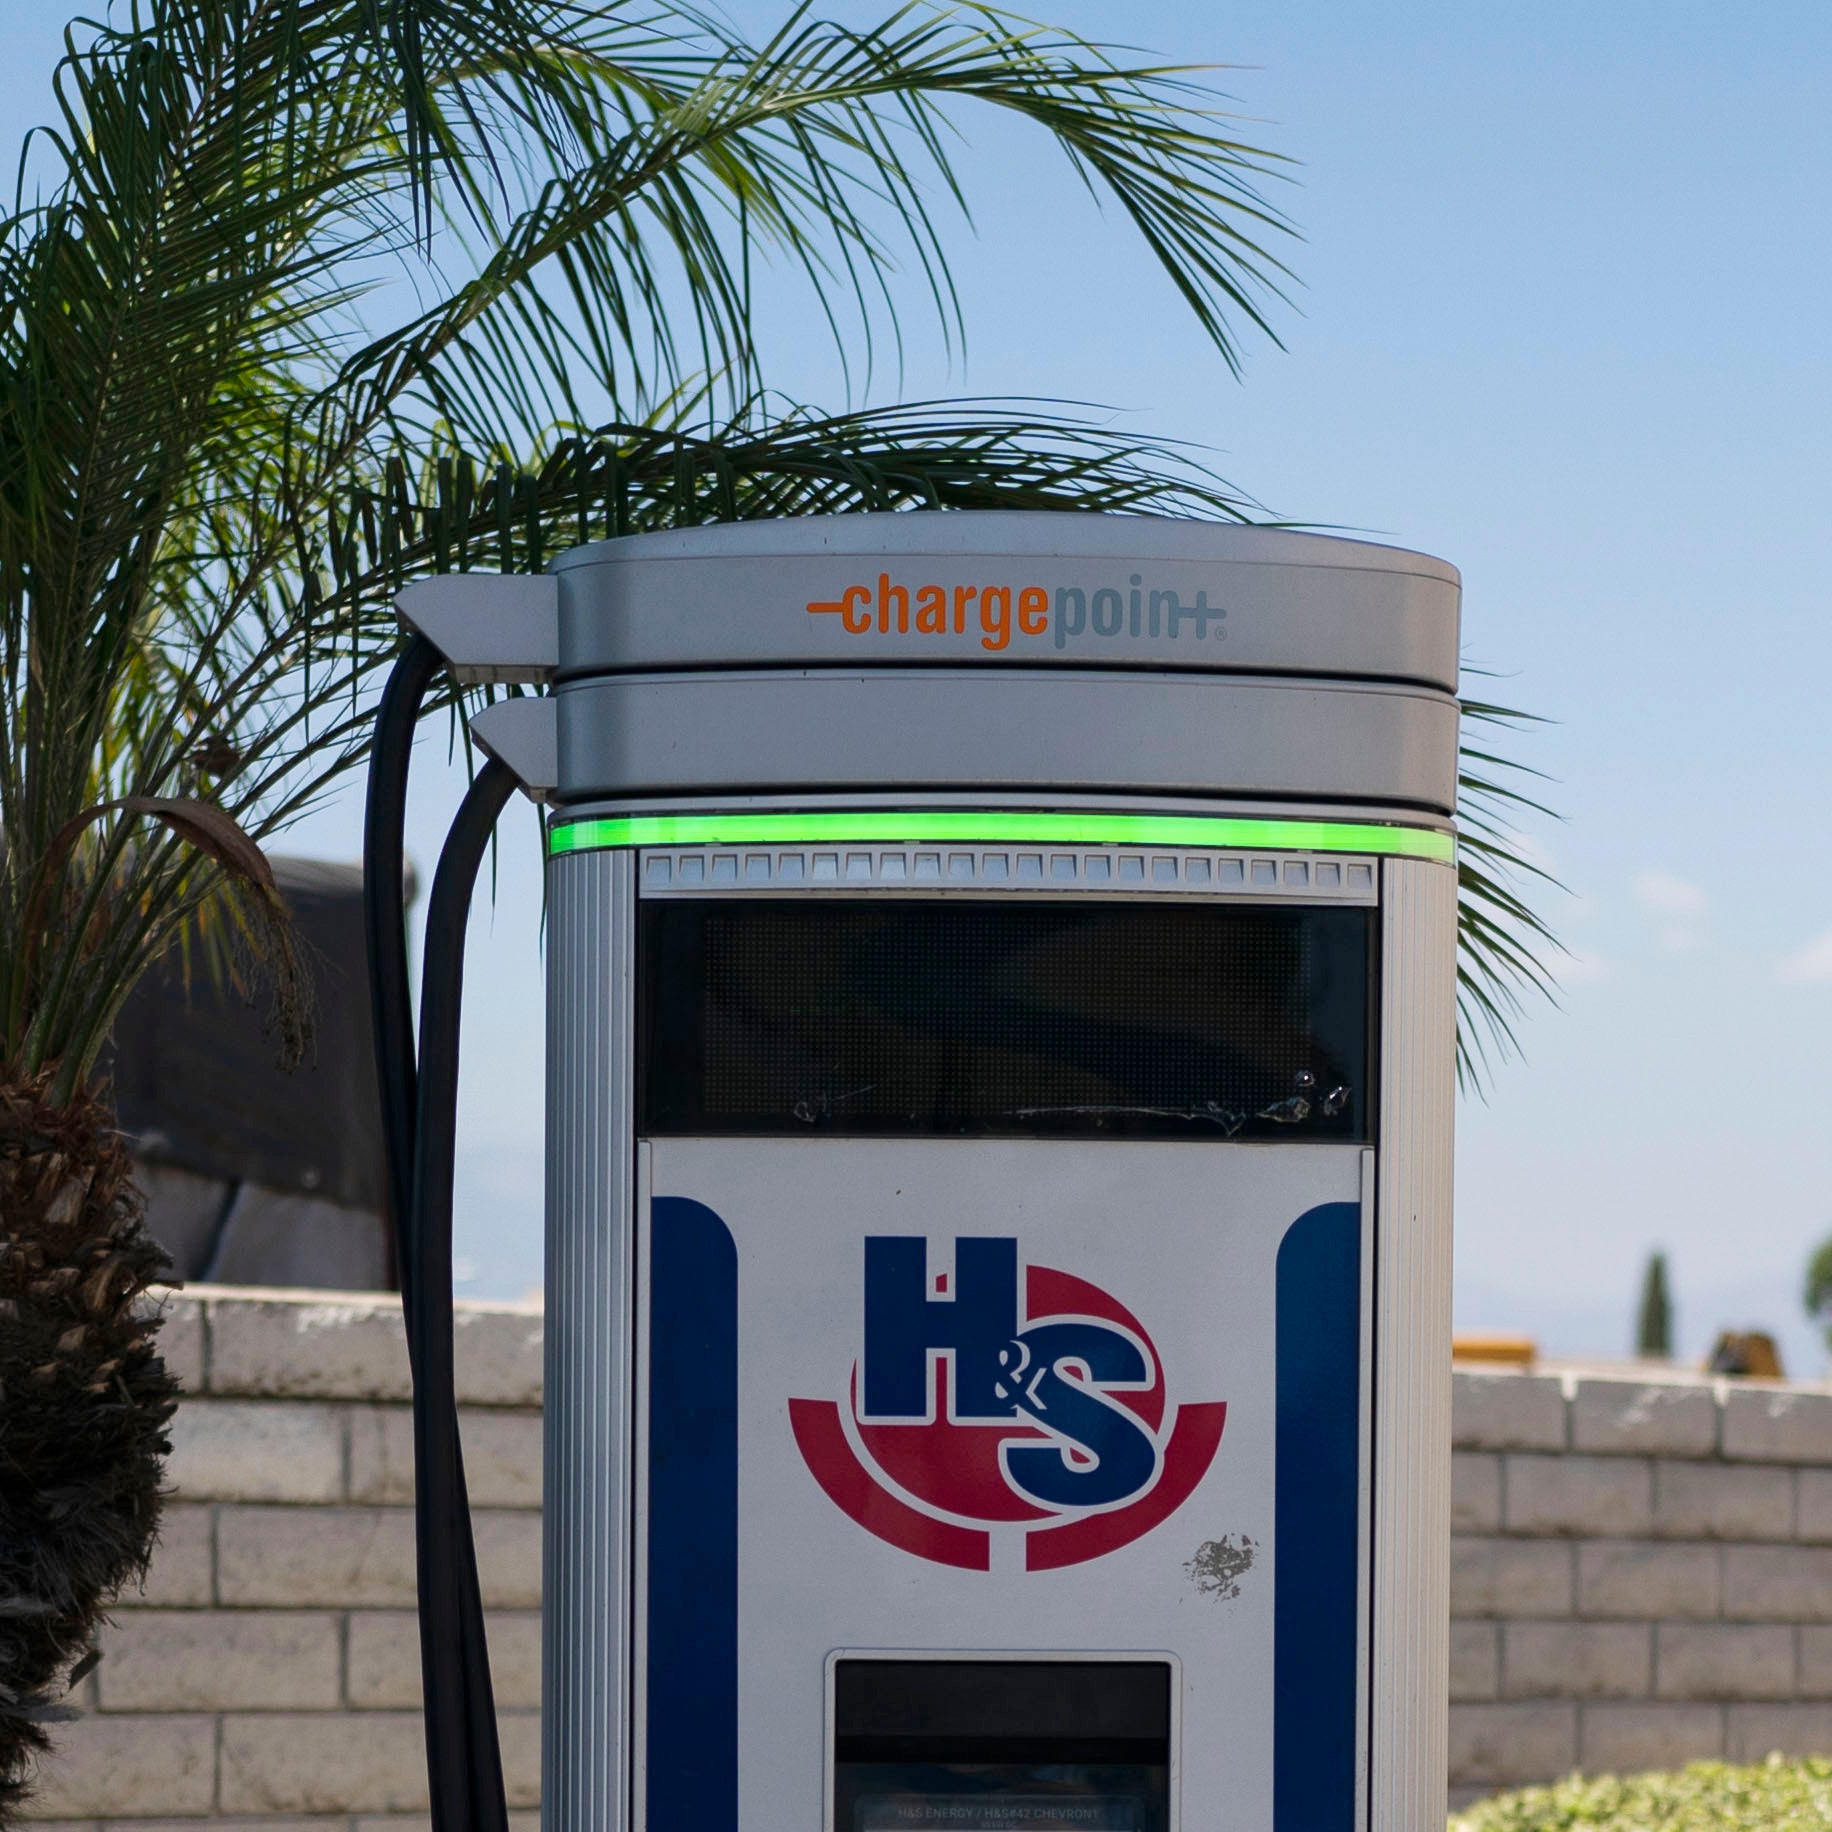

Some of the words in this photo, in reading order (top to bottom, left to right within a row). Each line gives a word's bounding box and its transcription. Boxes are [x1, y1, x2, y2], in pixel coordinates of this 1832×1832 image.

[806, 573, 1227, 651] chargepoint
[864, 1236, 1157, 1506] H&S
[926, 1807, 973, 1819] ENERGY
